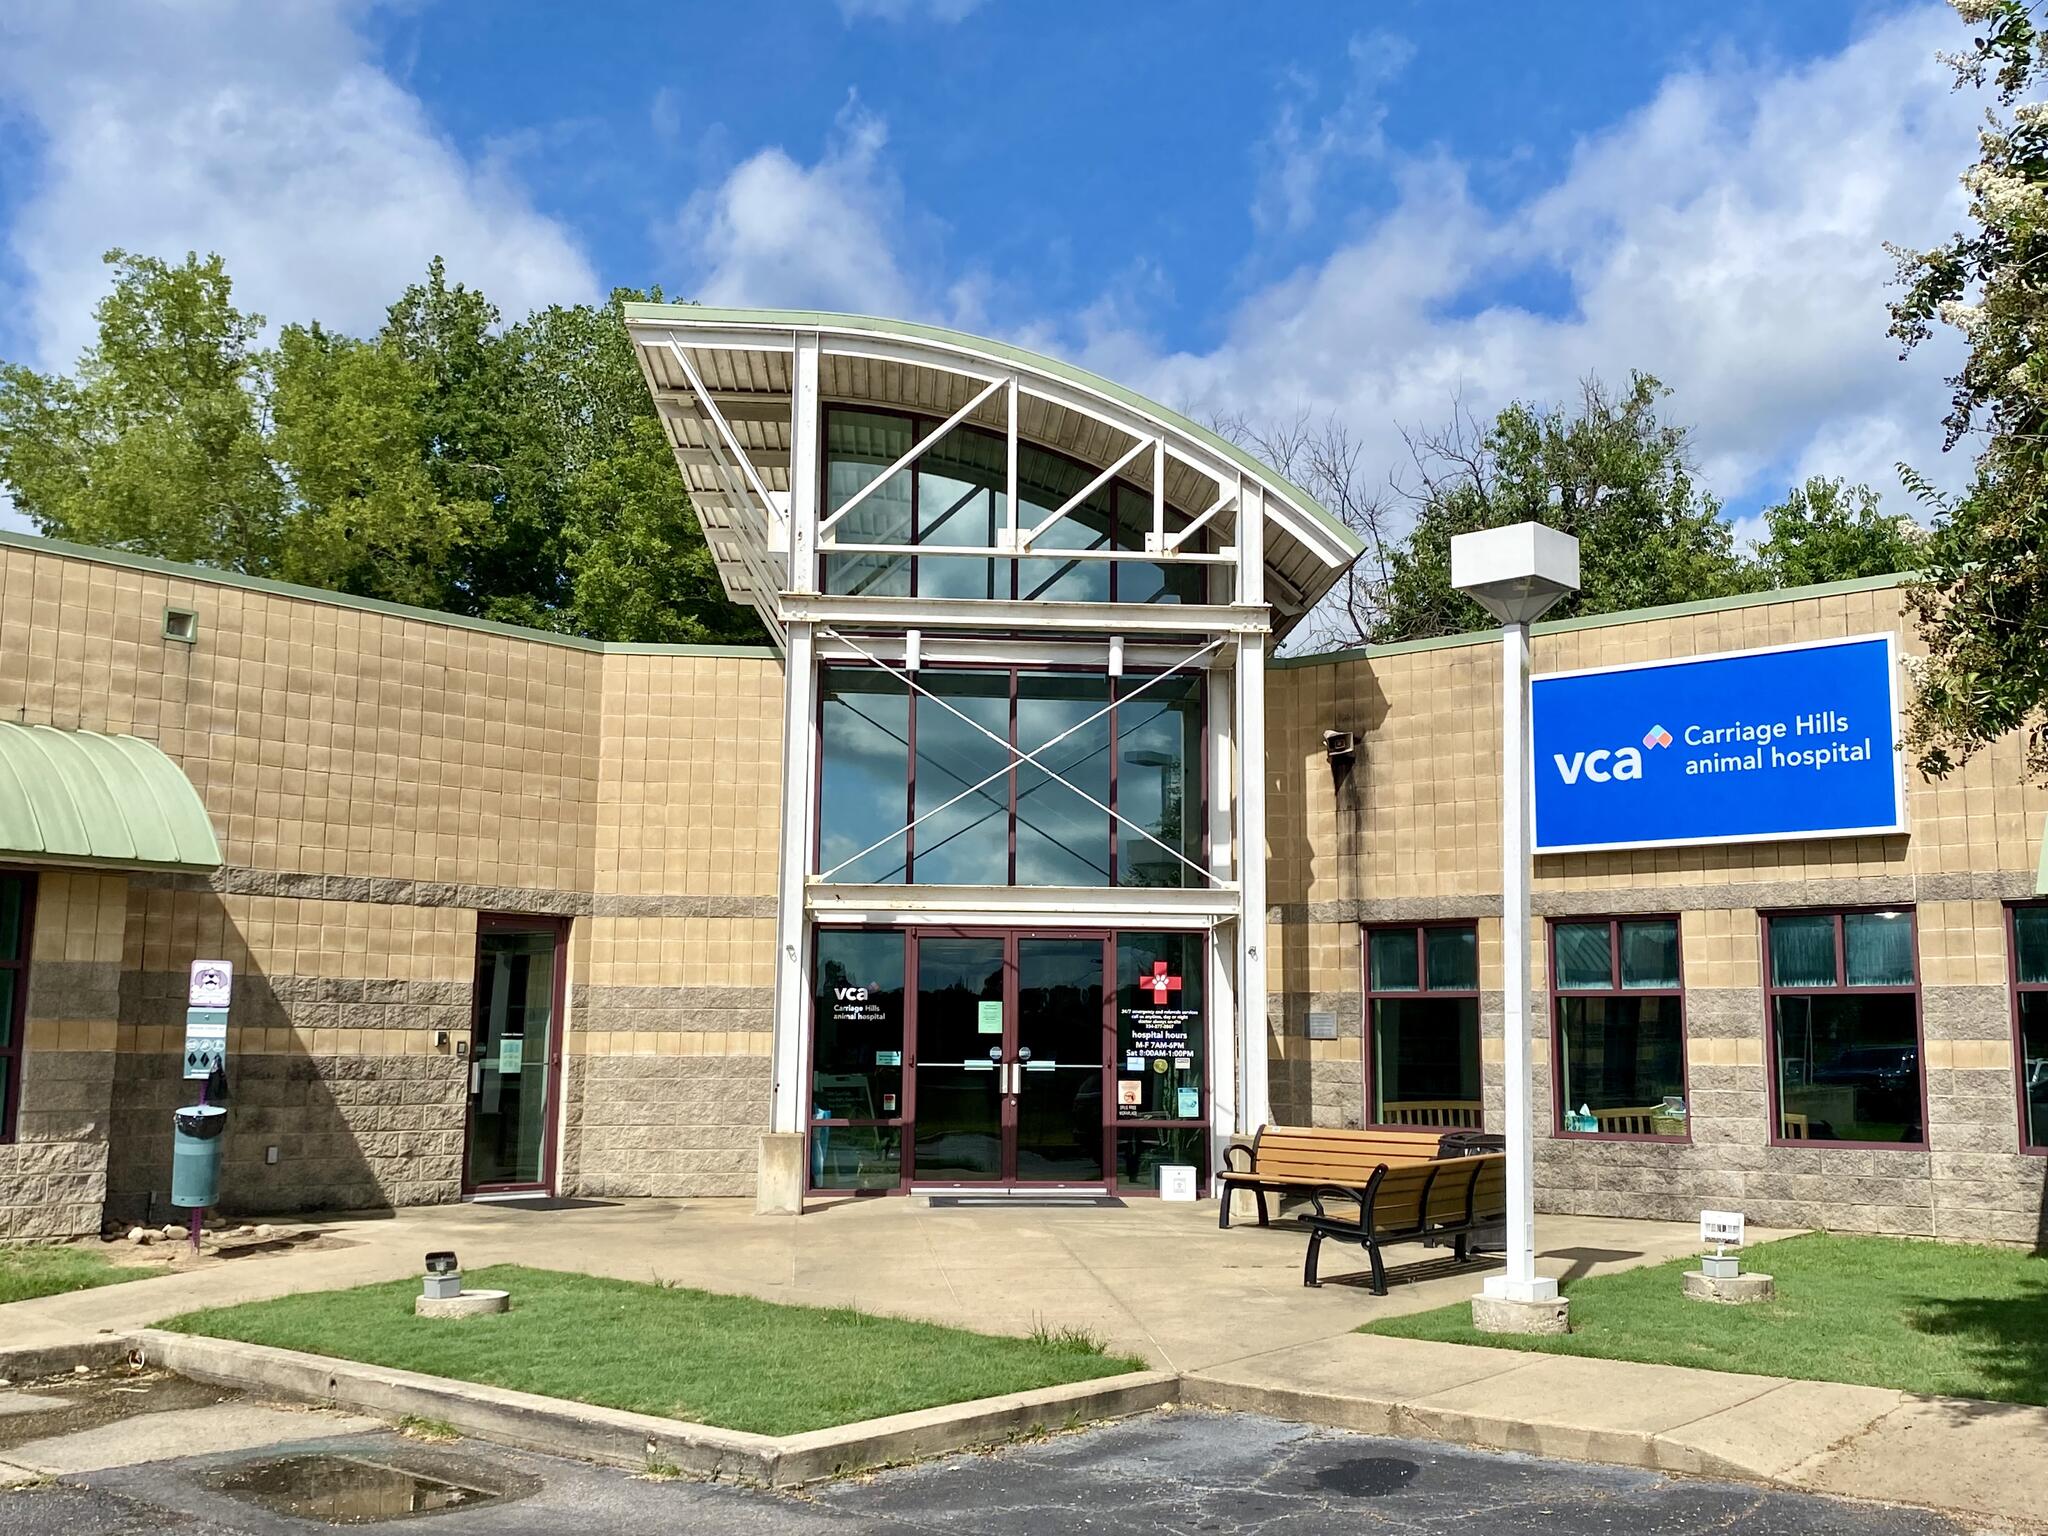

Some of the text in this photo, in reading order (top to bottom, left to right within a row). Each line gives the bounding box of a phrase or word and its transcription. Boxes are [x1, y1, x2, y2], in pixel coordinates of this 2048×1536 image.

[1684, 711, 1849, 748] Carriage Hills
[1685, 738, 1872, 775] animal hospital
[1553, 746, 1643, 785] vca
[834, 987, 868, 1001] vca
[833, 1004, 863, 1013] Carriage
[857, 1013, 886, 1021] hospital
[1132, 1030, 1188, 1040] hospital hours
